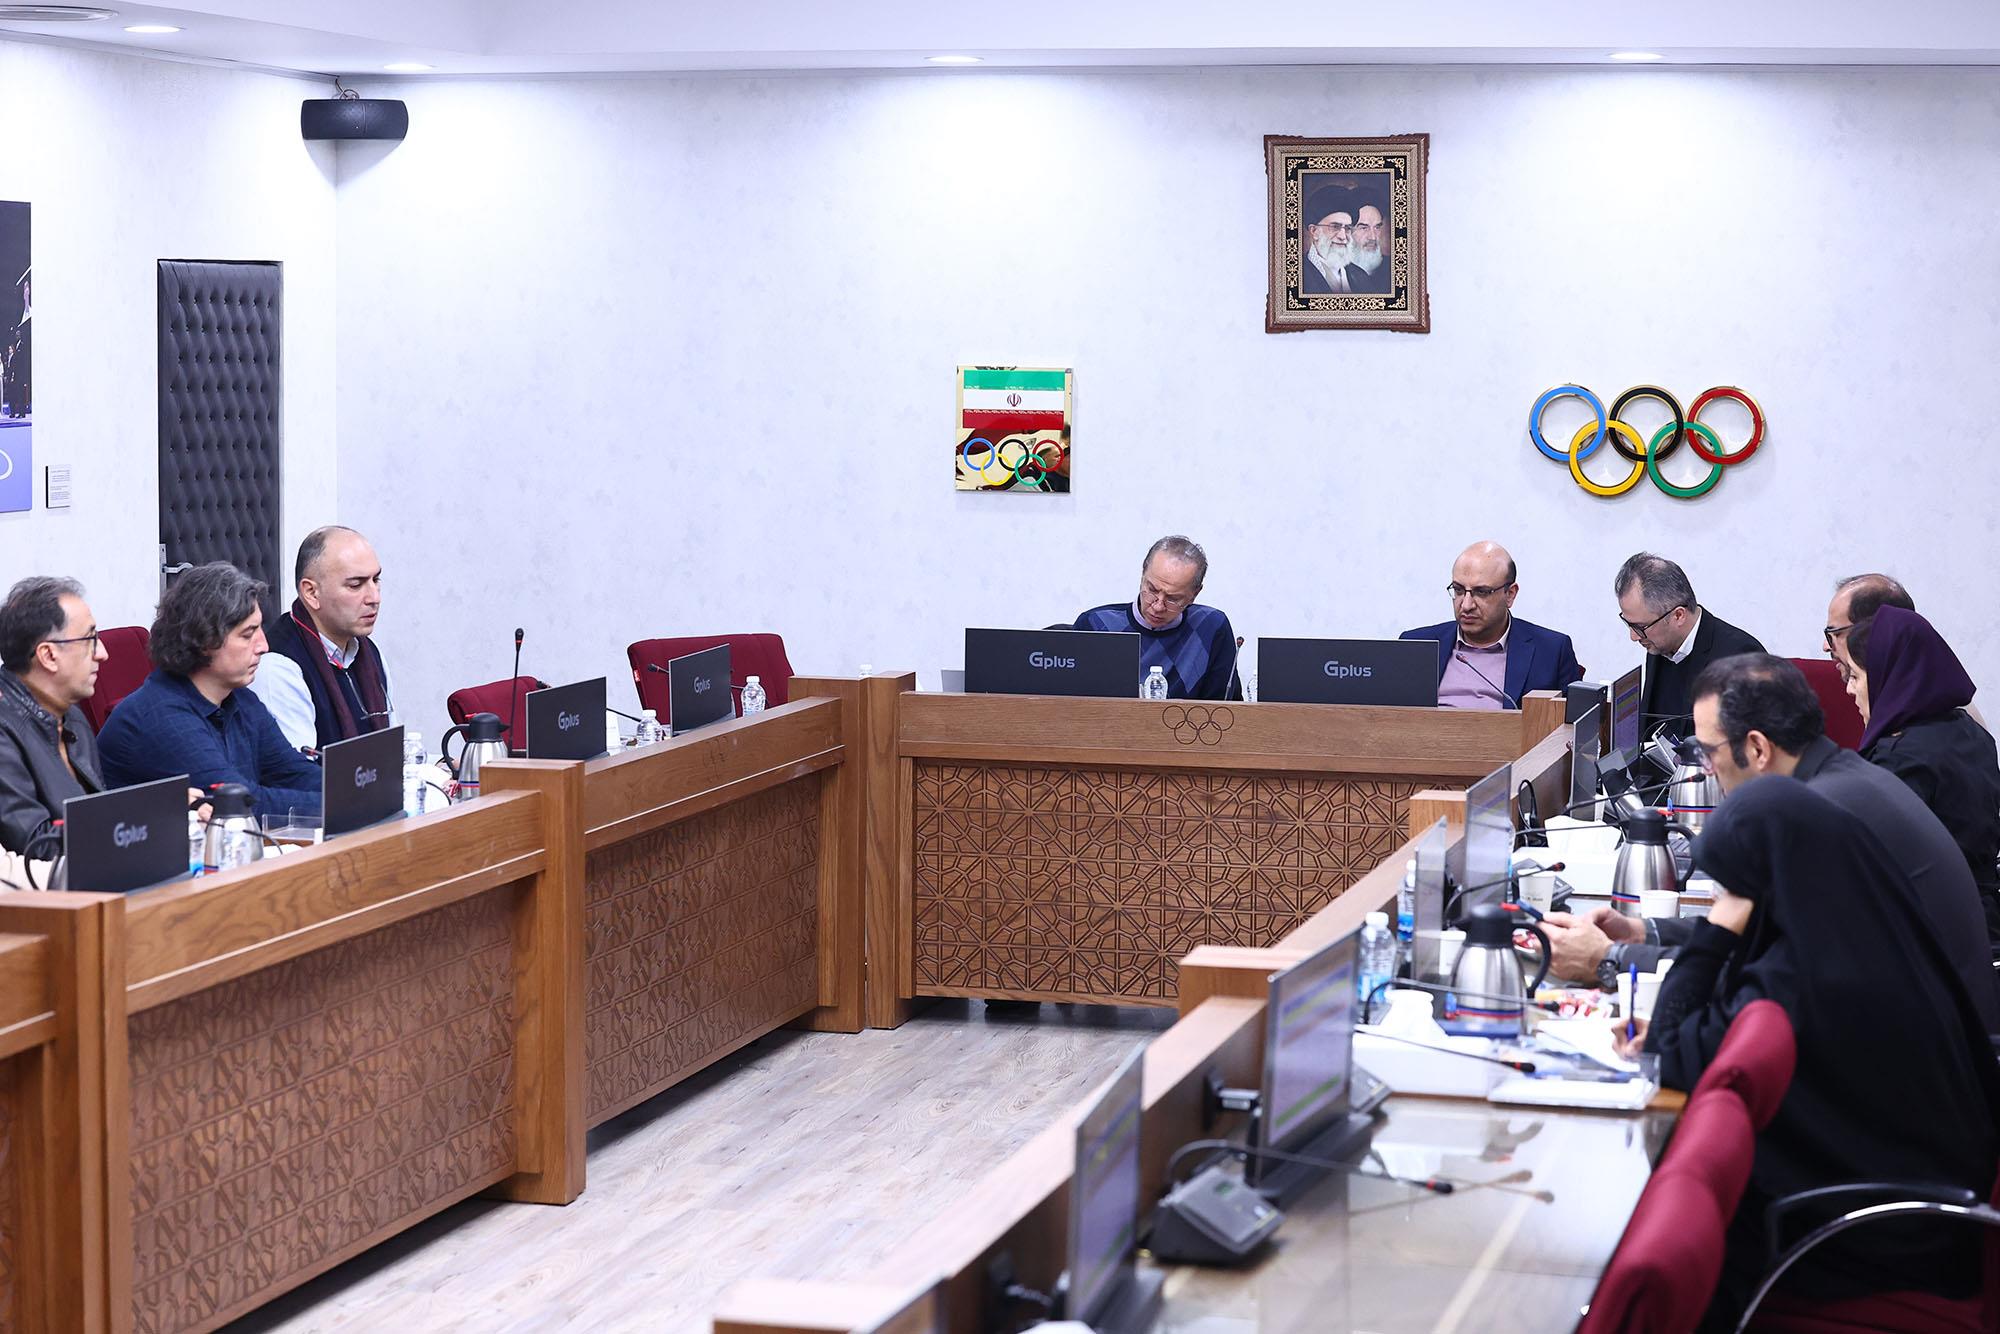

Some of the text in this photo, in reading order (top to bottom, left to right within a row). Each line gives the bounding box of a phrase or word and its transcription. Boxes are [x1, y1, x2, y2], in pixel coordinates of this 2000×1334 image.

[1029, 651, 1075, 670] Gplus
[1324, 660, 1372, 679] Gplus
[693, 676, 711, 694] Gplus
[557, 711, 580, 731] Gplus
[354, 765, 377, 787] Gplus
[113, 822, 148, 848] Gplus
